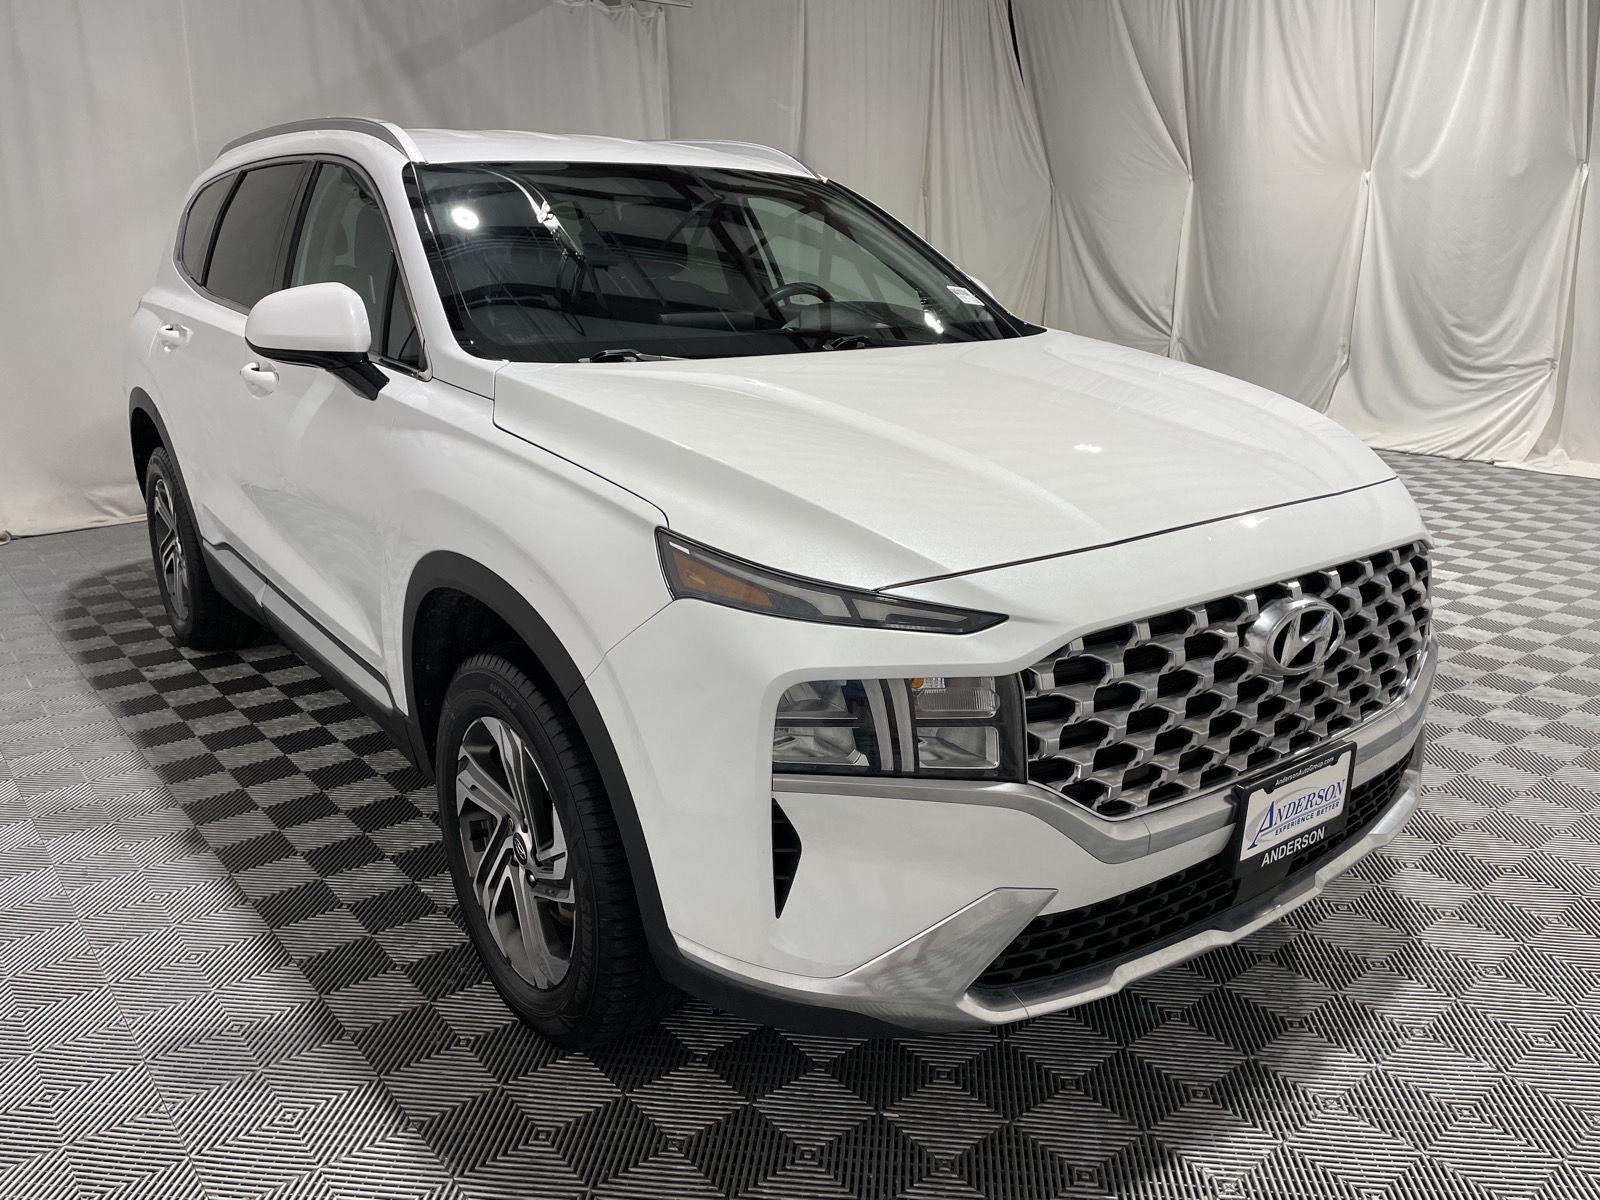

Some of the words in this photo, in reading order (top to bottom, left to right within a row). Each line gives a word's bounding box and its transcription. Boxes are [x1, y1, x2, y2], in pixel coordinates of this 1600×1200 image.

[1247, 779, 1345, 850] ANDERSON
[1275, 813, 1314, 835] EXPERIENCE
[1316, 801, 1340, 816] BETTER
[1261, 826, 1325, 867] ANDERSON
